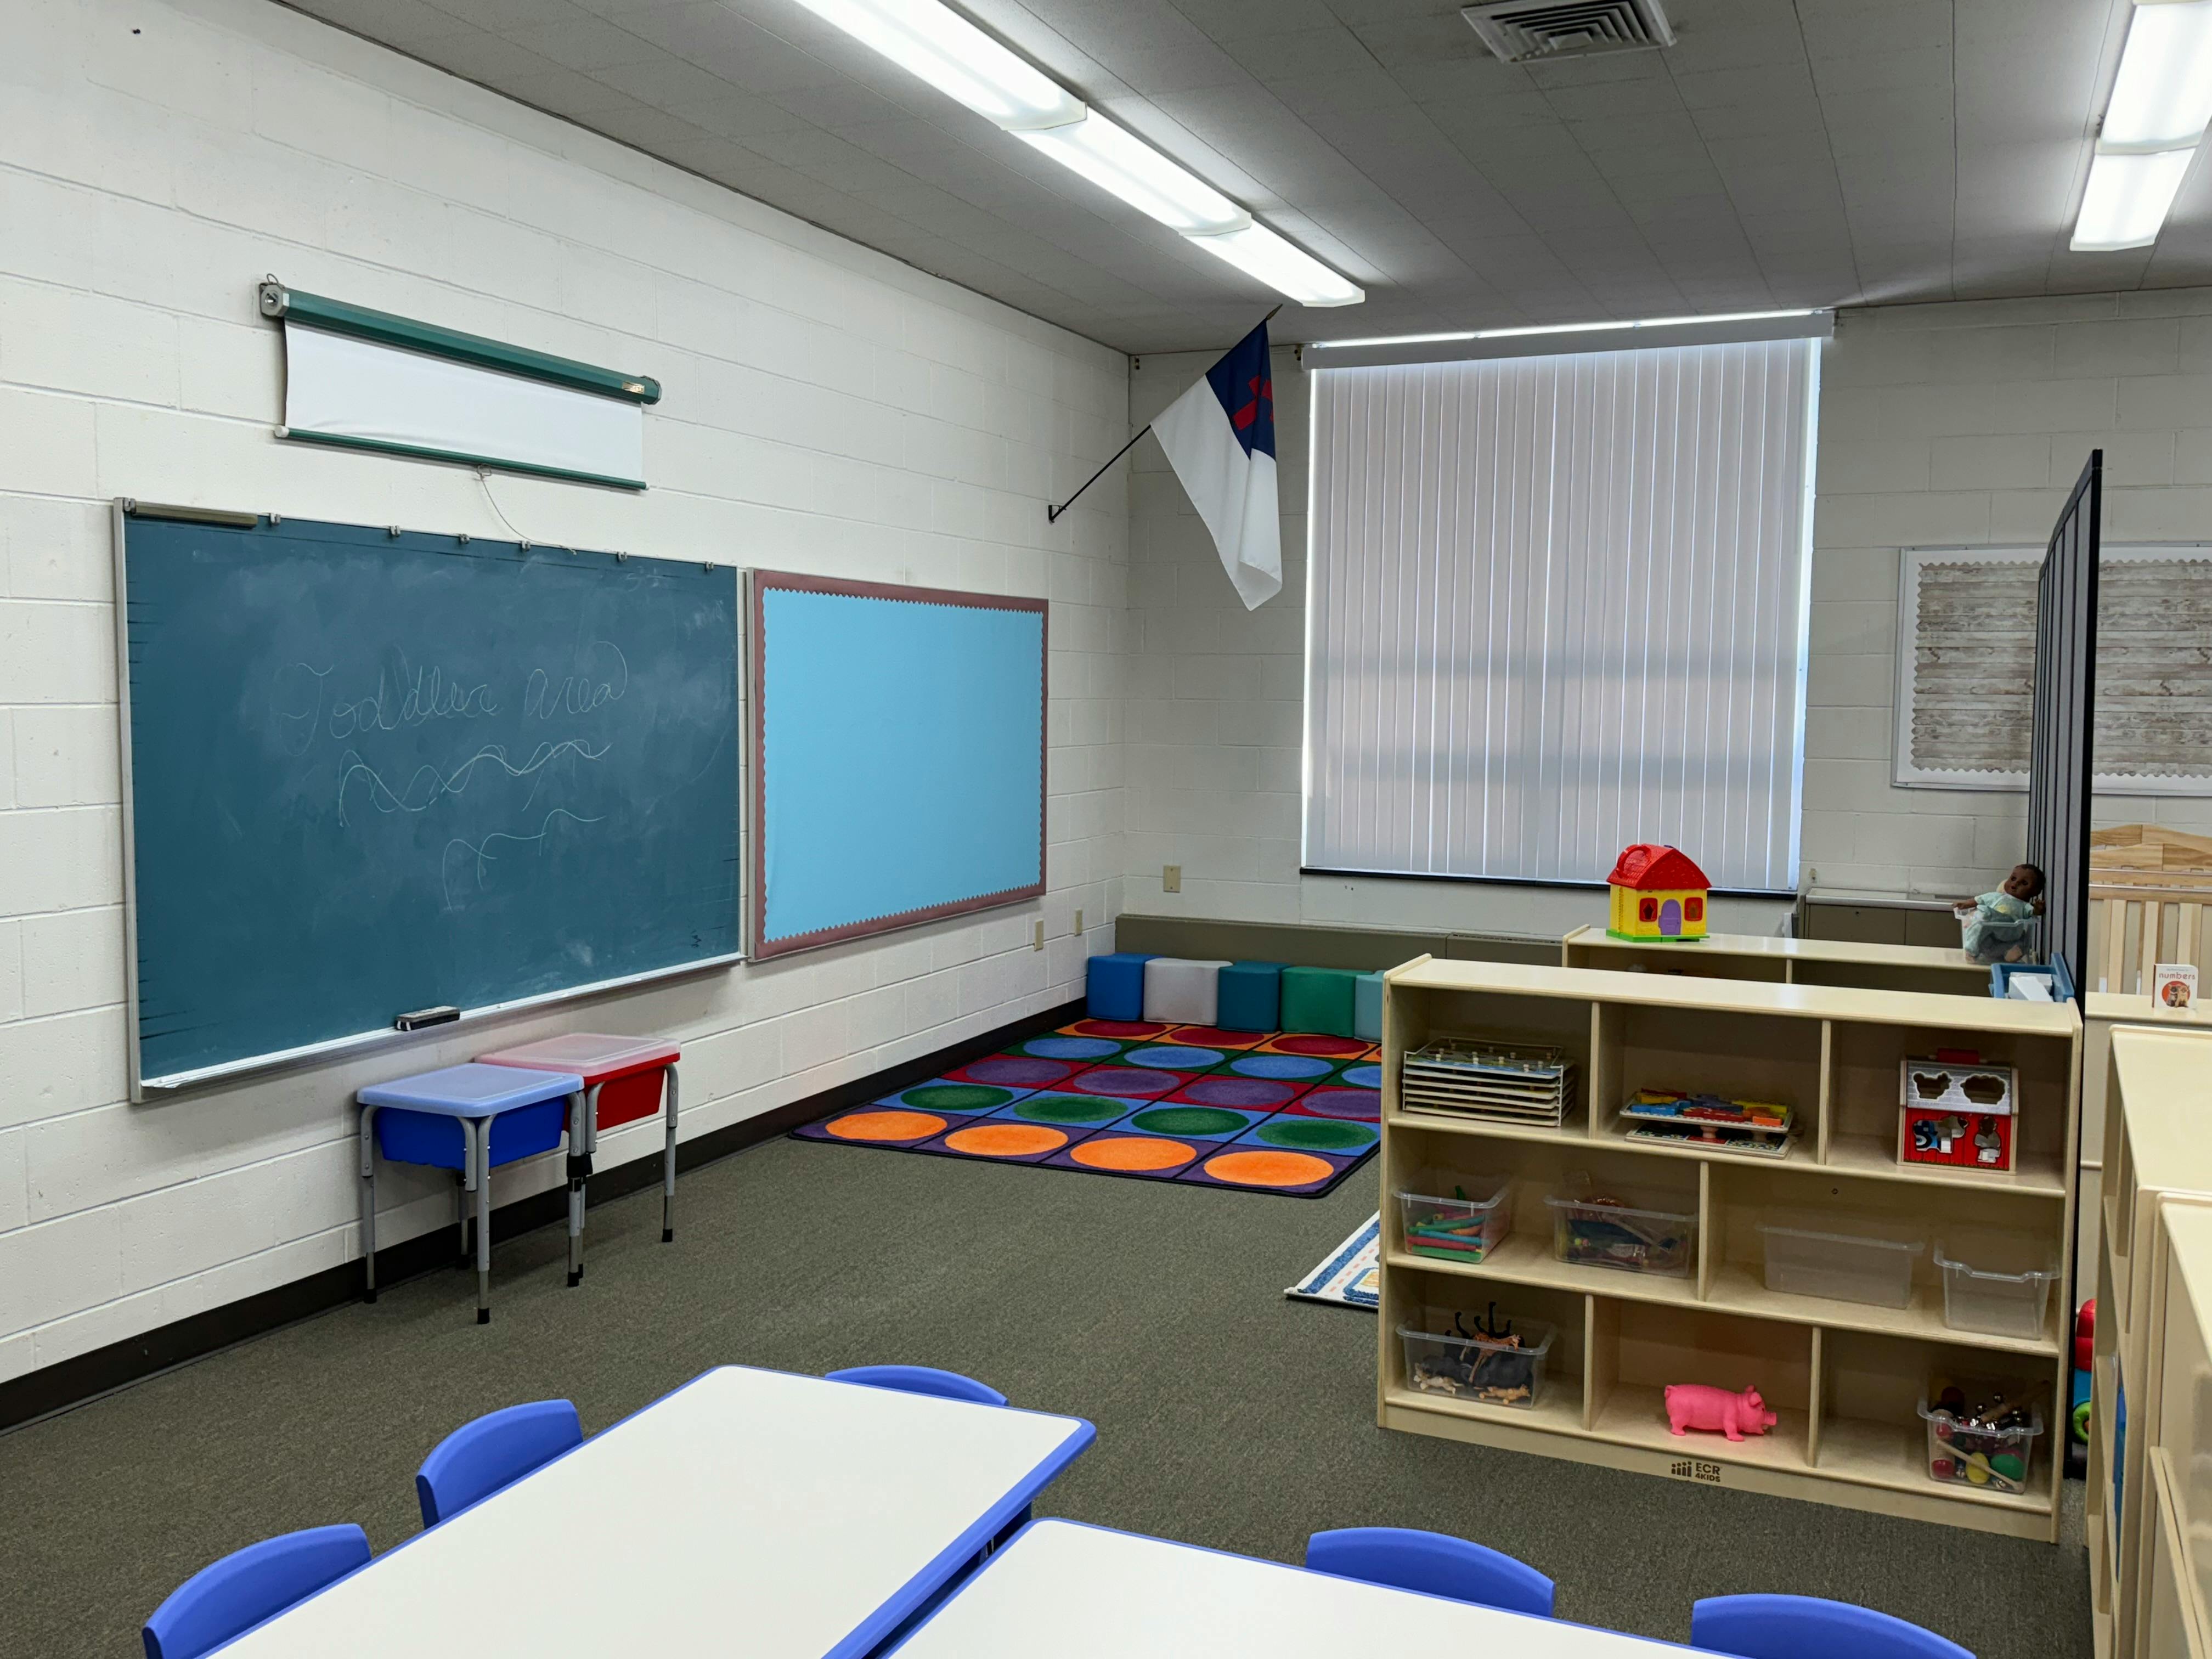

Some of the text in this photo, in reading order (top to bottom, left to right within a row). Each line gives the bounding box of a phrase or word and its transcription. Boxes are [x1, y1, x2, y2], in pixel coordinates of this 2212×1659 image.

[275, 647, 498, 756] Toddler
[2159, 972, 2196, 980] numbers
[1696, 1462, 1720, 1475] ECR
[1695, 1472, 1721, 1482] 4KIDS
